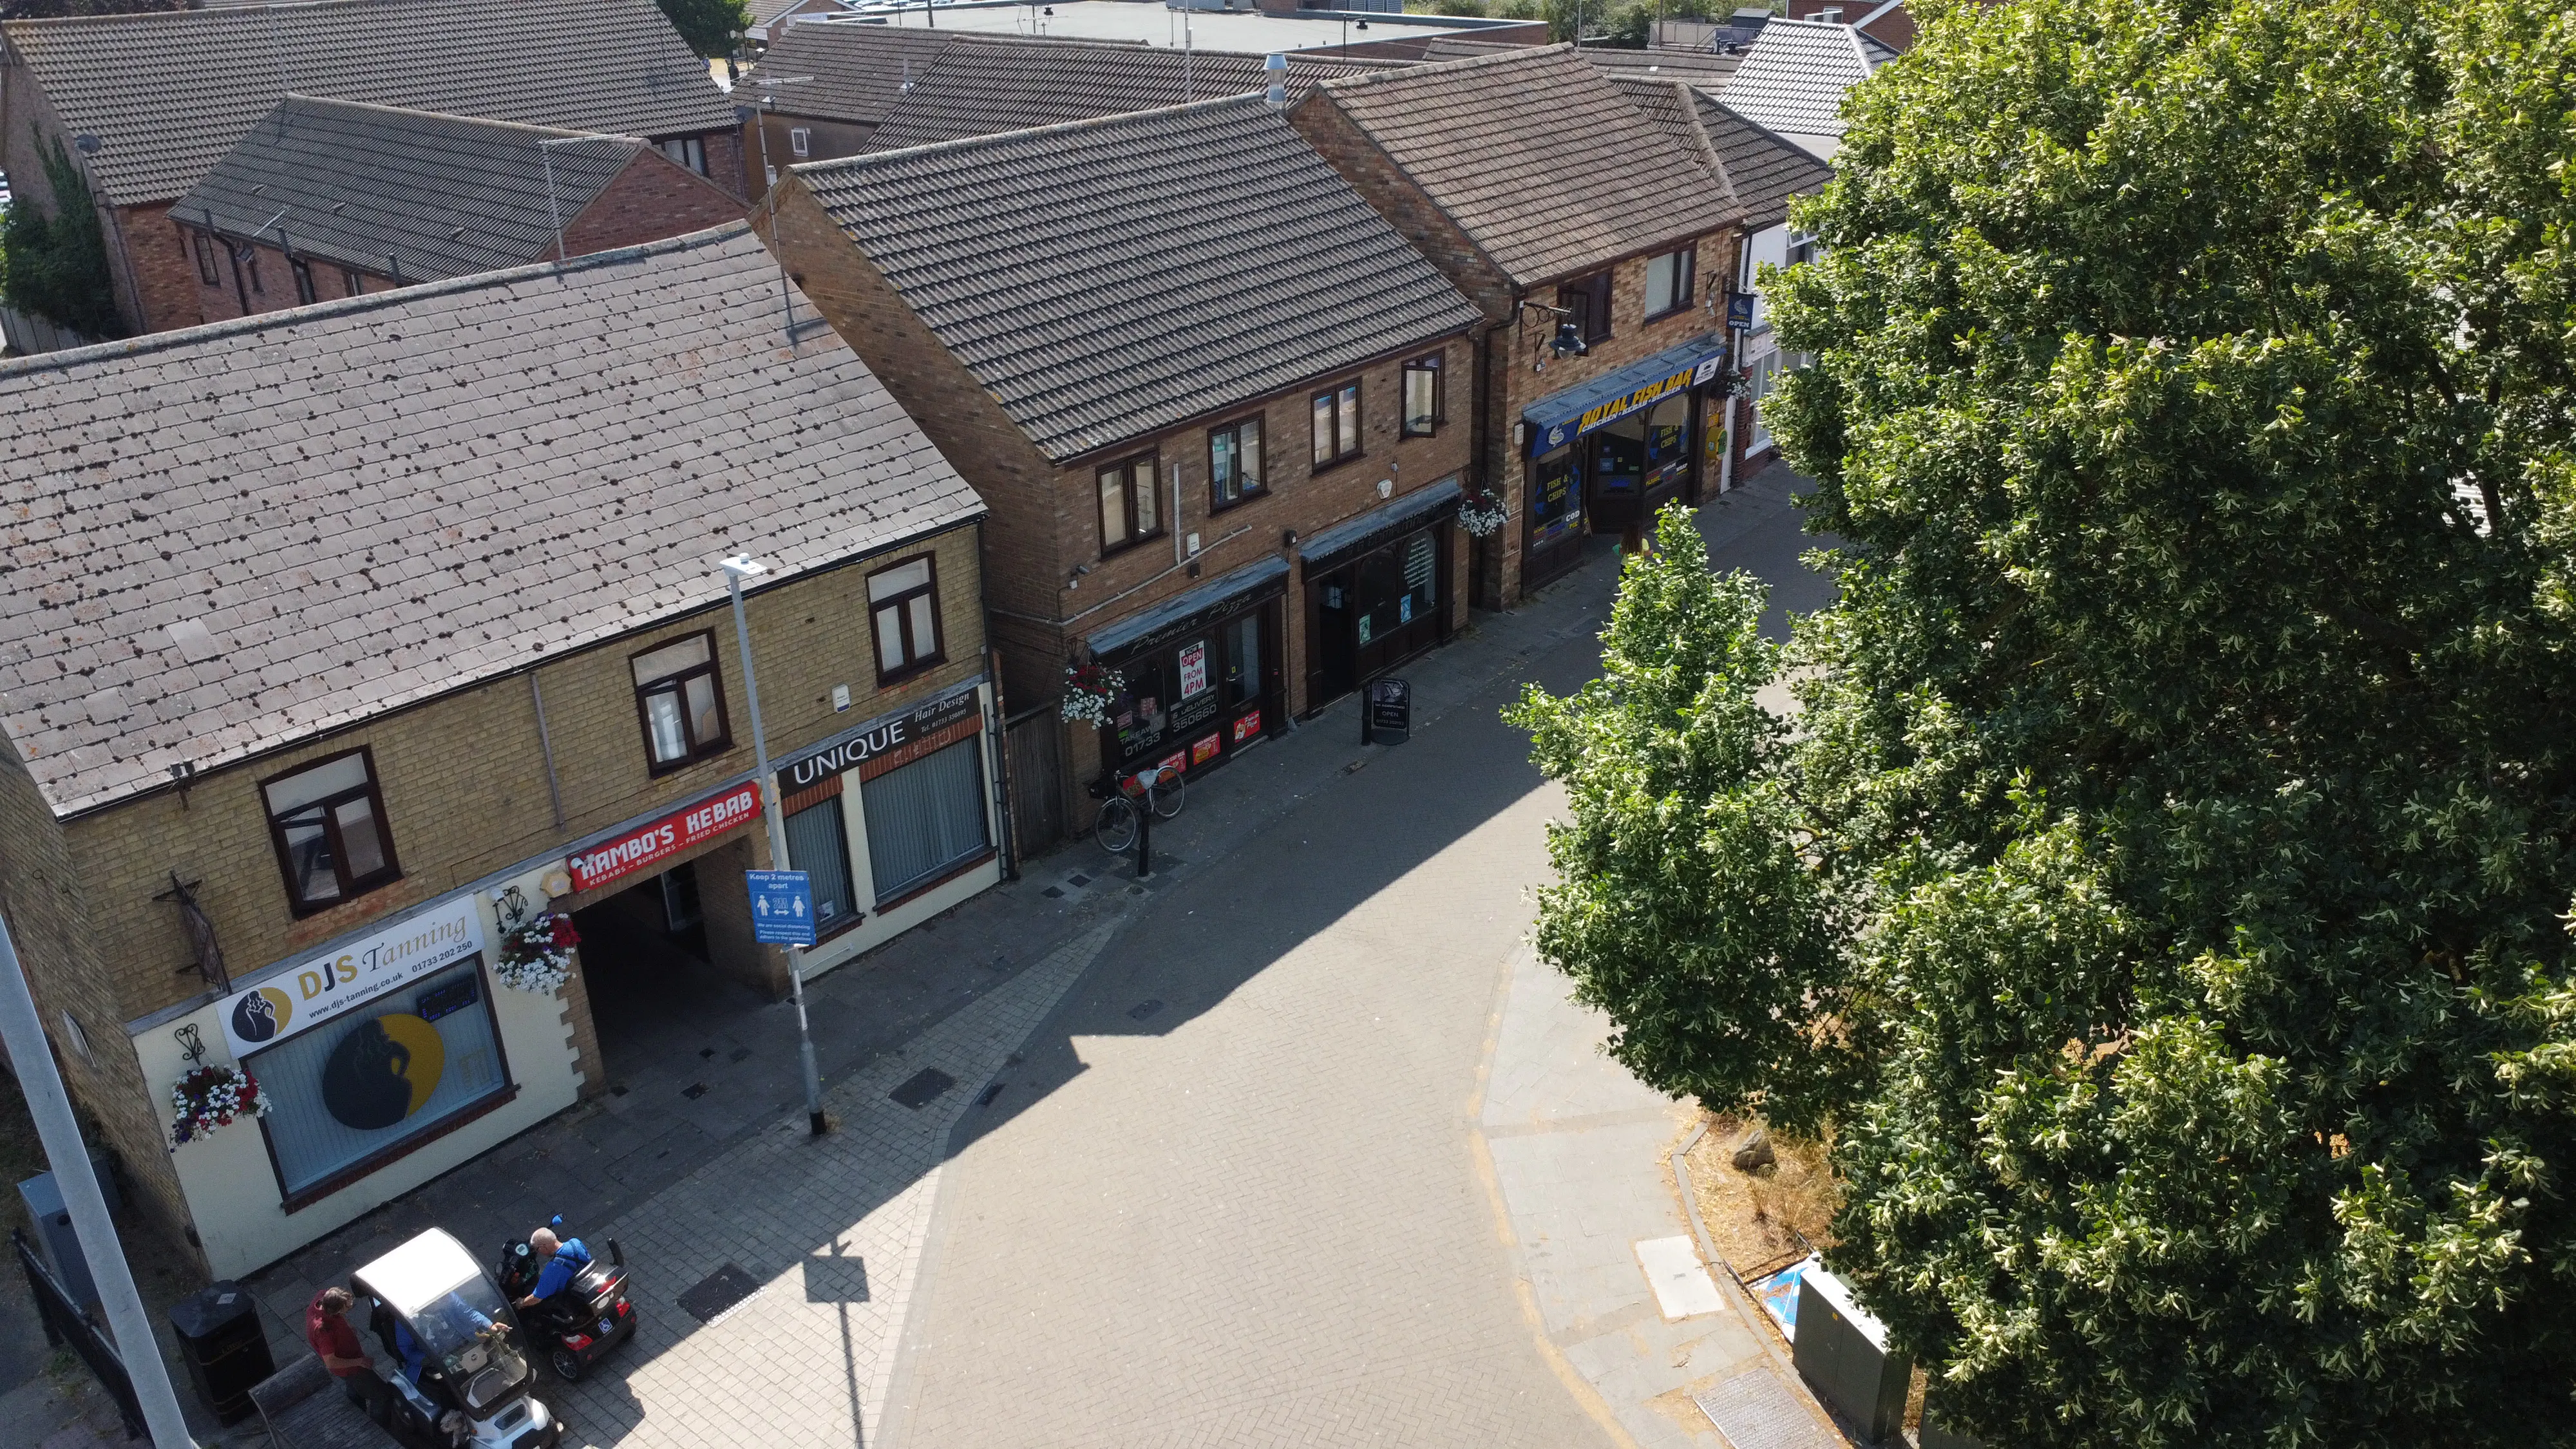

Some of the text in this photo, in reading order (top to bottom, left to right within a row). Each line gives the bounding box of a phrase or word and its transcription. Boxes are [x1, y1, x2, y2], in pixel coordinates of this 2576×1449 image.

[1632, 379, 1663, 404] FISH
[1666, 368, 1694, 388] BAR
[1582, 413, 1618, 433] CHICKEN
[1622, 400, 1647, 416] KEBAB
[1651, 386, 1681, 402] BURGER
[1660, 426, 1672, 438] FISH
[1661, 435, 1677, 448] CHIPS
[1547, 474, 1569, 491] FISH &
[1548, 487, 1566, 502] CHIPS
[1566, 510, 1580, 522] COD
[1131, 592, 1251, 654] Premier Pizza
[1182, 649, 1203, 667] OPEN
[1186, 645, 1198, 656] NOW
[1184, 666, 1203, 682] FROM
[1184, 677, 1204, 696] 4PM
[914, 692, 969, 723] Hair Design
[921, 724, 931, 733] Tel.
[932, 717, 947, 728] 01733
[1124, 703, 1217, 757] 01733 350660
[794, 721, 906, 784] UNIQUE
[686, 791, 753, 835] KEBAB
[589, 812, 749, 886] KEBABS BURGERS FRIED CHICKEN
[298, 916, 466, 1000] DJS Tanning
[309, 940, 473, 1018] www.djs-tanning.co.uk 01733 202 250
